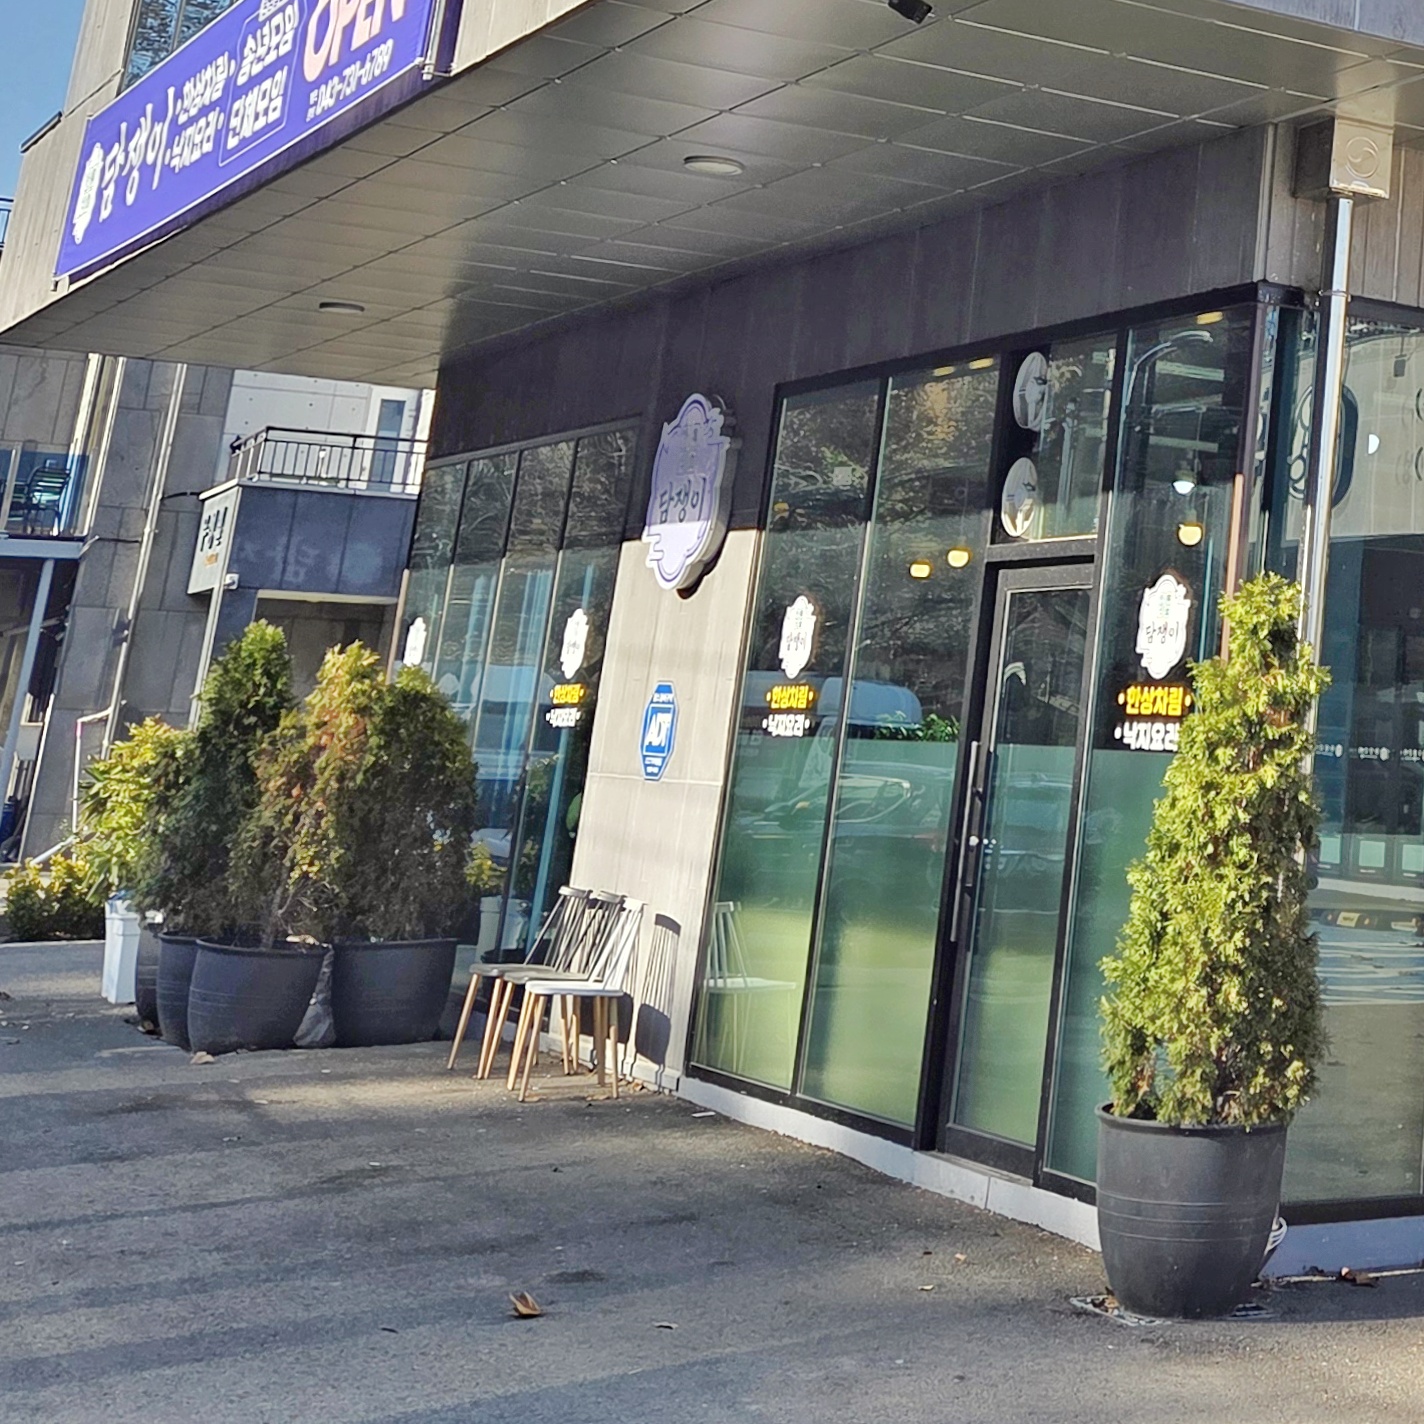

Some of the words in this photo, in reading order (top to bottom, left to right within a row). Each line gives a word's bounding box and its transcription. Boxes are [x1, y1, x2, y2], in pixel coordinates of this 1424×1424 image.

[237, 0, 299, 86] 송년모임
[178, 51, 228, 125] 한상차림
[227, 66, 288, 149] 단체모임
[316, 39, 394, 116] 043-731-6789
[99, 86, 175, 223] 담쟁이
[170, 107, 220, 173] 낙지요리
[659, 477, 706, 524] 담쟁이
[1146, 621, 1179, 644] 담쟁이
[645, 713, 672, 747] ADT
[771, 685, 809, 709] 한상차림
[1126, 685, 1183, 716] 한상차림
